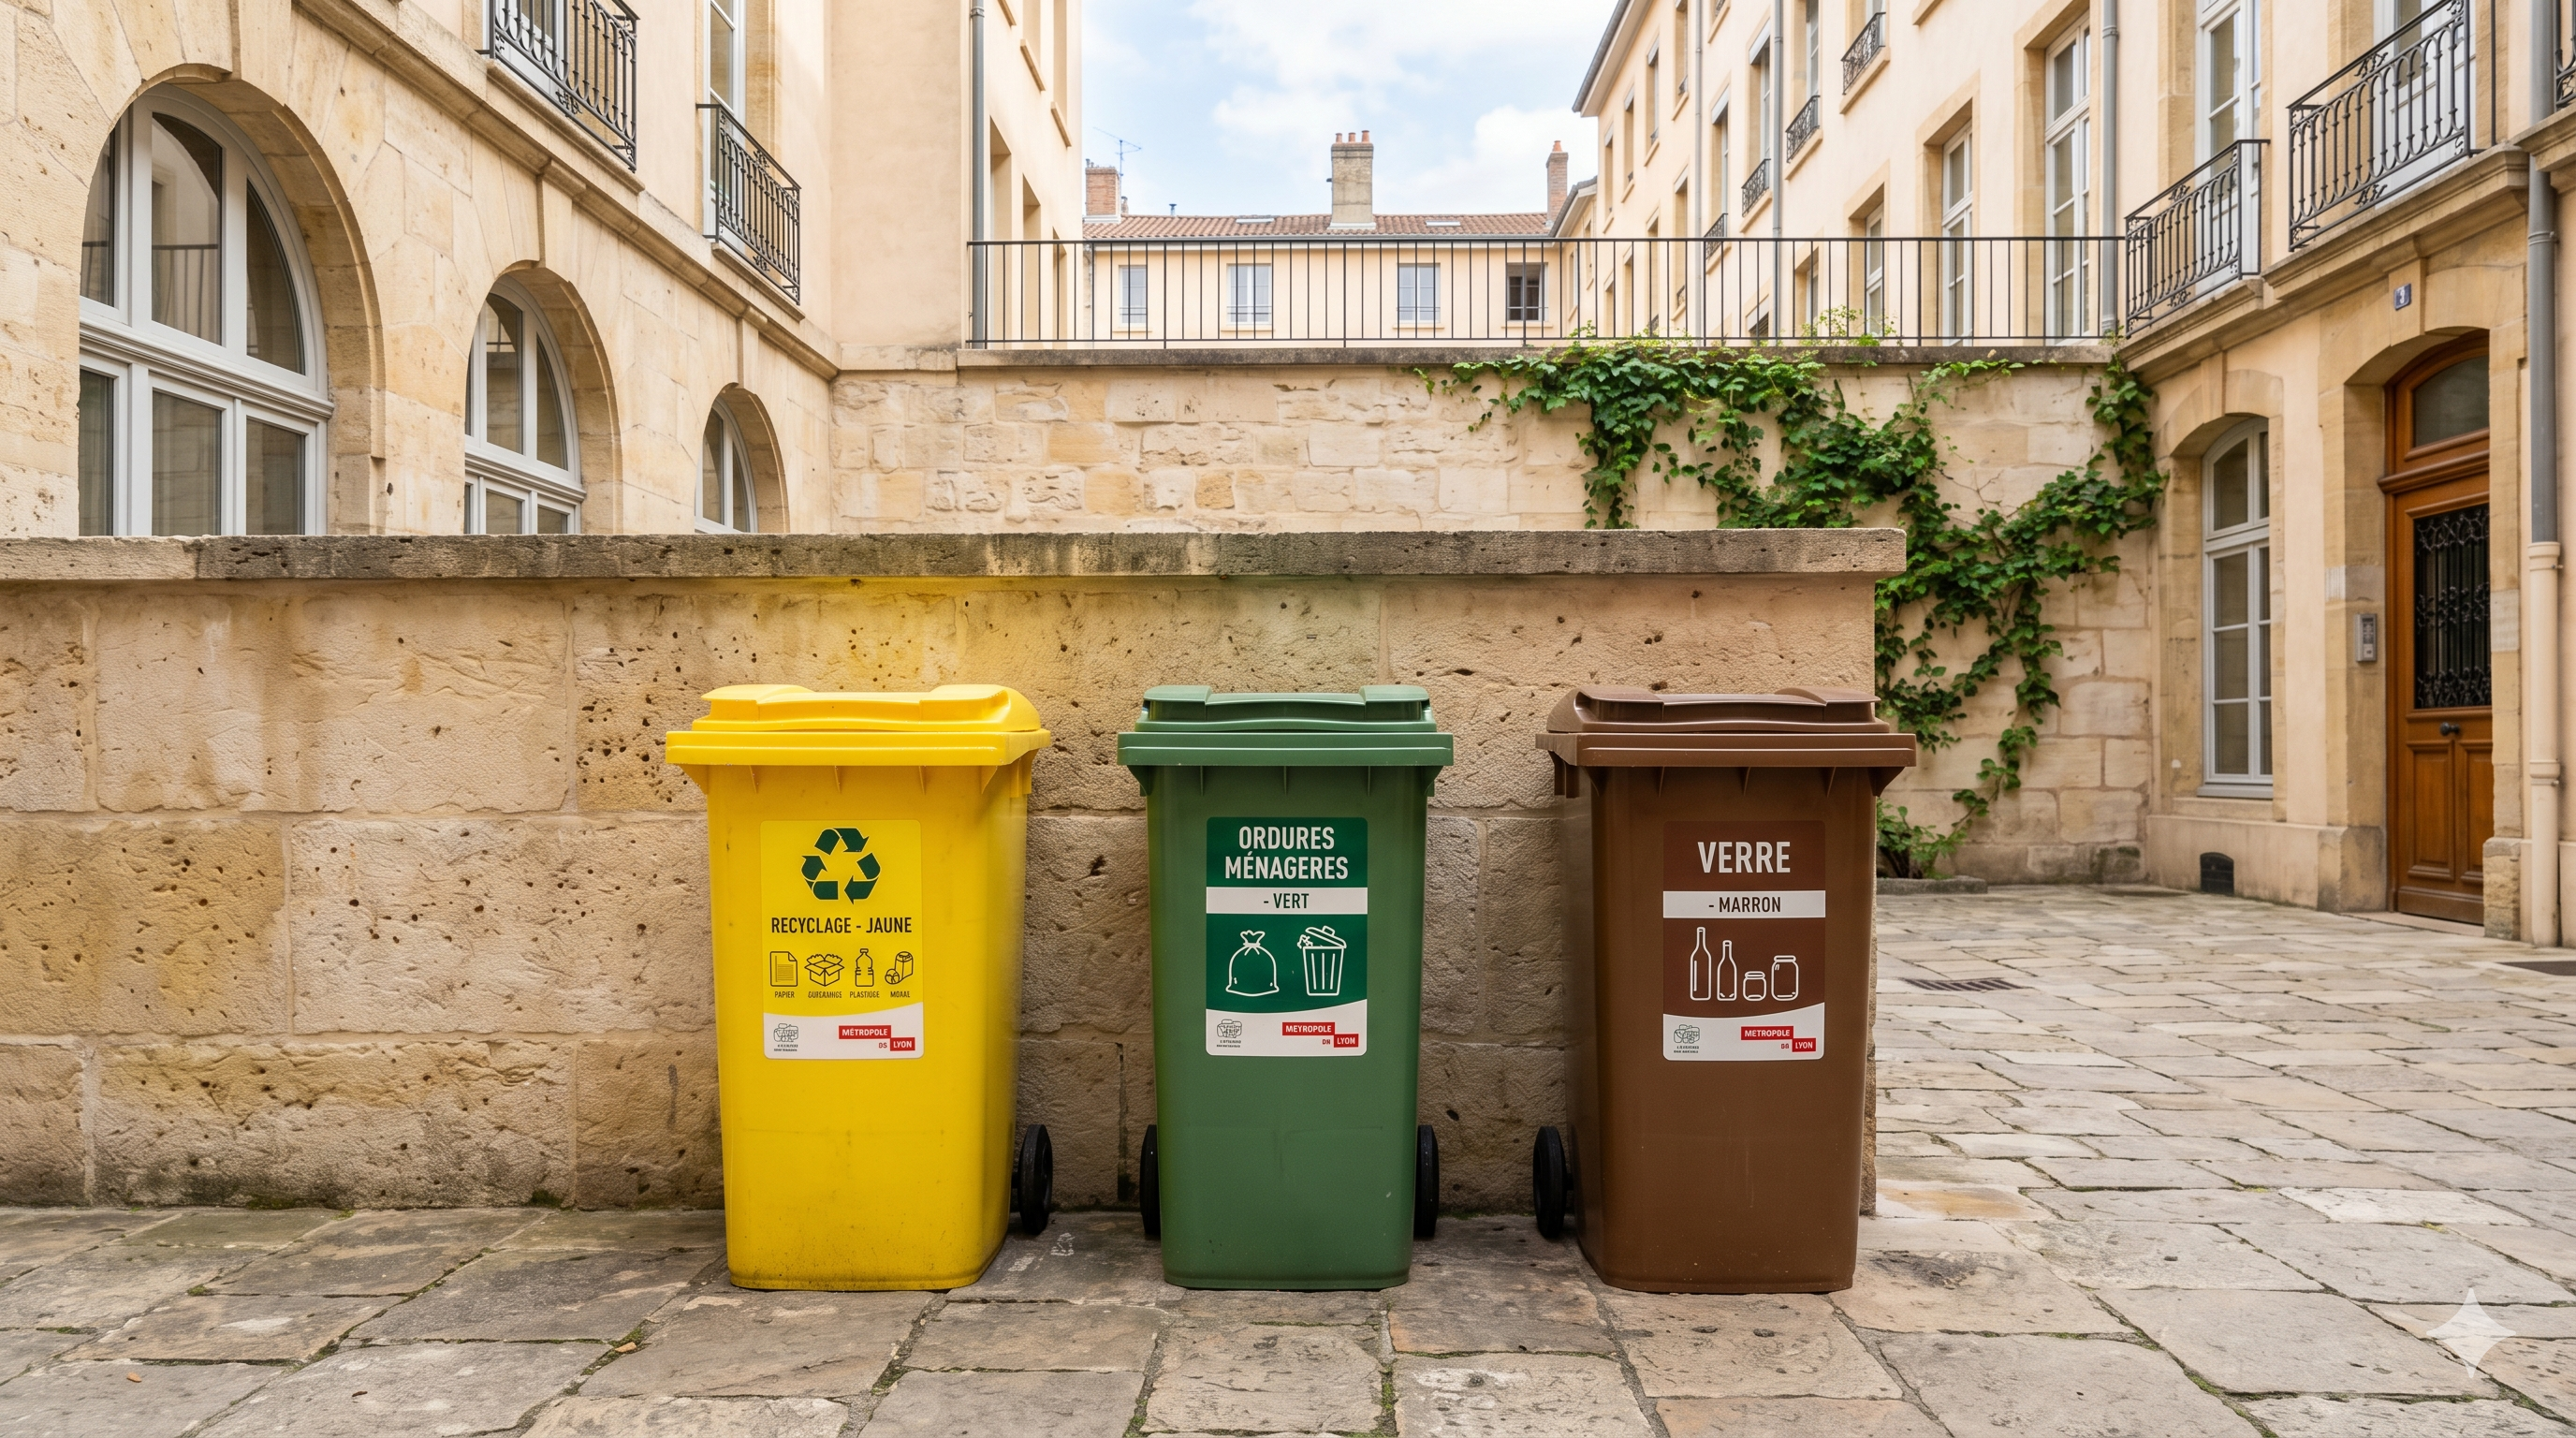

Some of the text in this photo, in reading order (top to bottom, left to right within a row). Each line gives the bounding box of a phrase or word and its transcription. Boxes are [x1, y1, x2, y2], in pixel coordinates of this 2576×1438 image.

[1238, 827, 1335, 849] ORDURES
[1225, 851, 1349, 879] MÉNAGERES
[1697, 842, 1791, 873] VERRE
[1273, 893, 1310, 908] VERT
[1719, 897, 1781, 912] MARRON
[771, 917, 852, 933] RECYCLAGE
[865, 917, 913, 932] JAUNE
[774, 990, 795, 999] PAPIER
[893, 1040, 913, 1049] LYON
[1794, 1041, 1813, 1049] LYON
